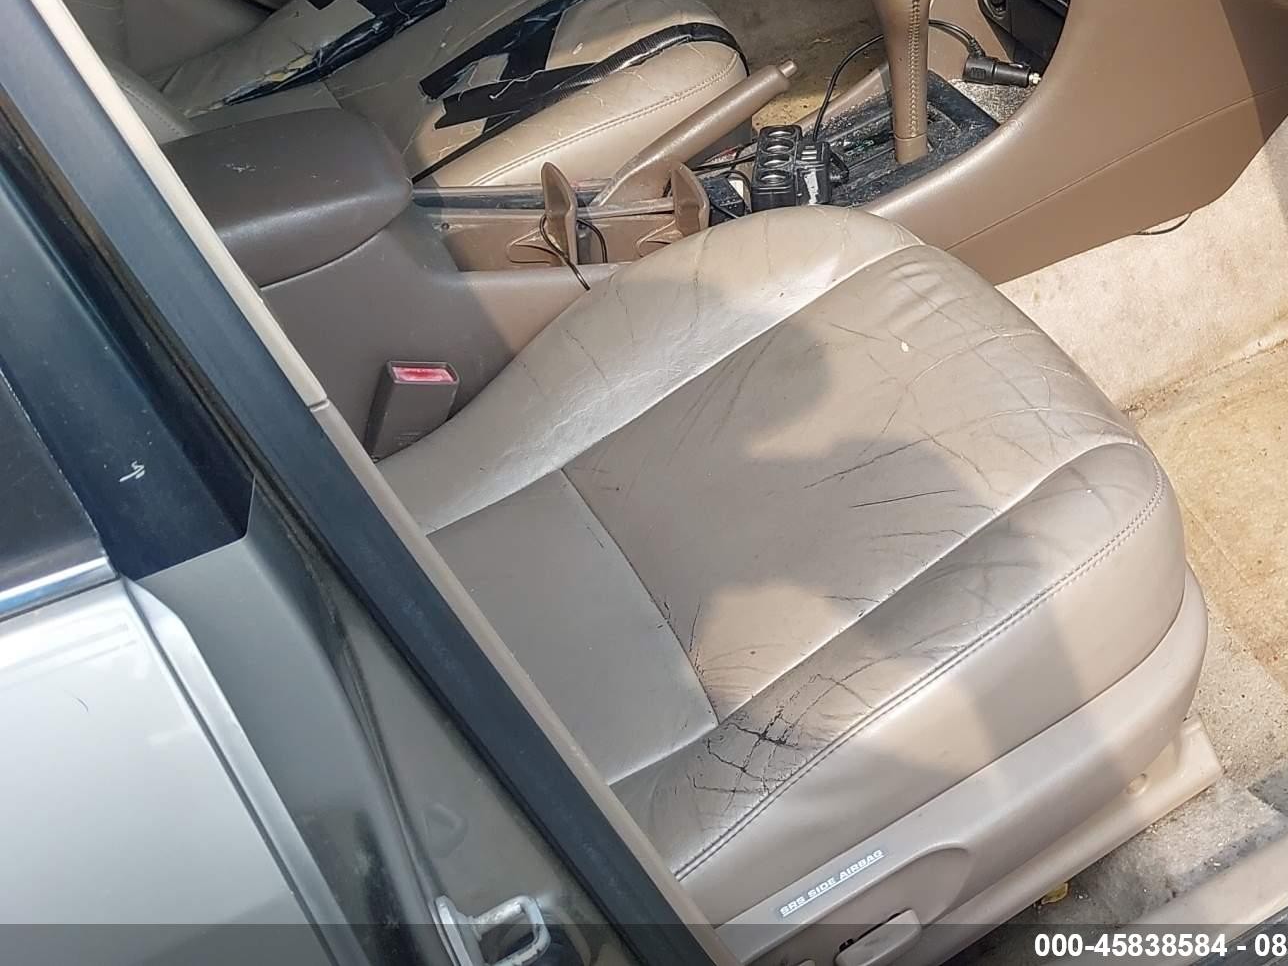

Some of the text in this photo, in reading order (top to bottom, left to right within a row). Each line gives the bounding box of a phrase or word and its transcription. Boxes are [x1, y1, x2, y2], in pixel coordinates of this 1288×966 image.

[780, 849, 884, 917] SRS SIDE AIRBAG
